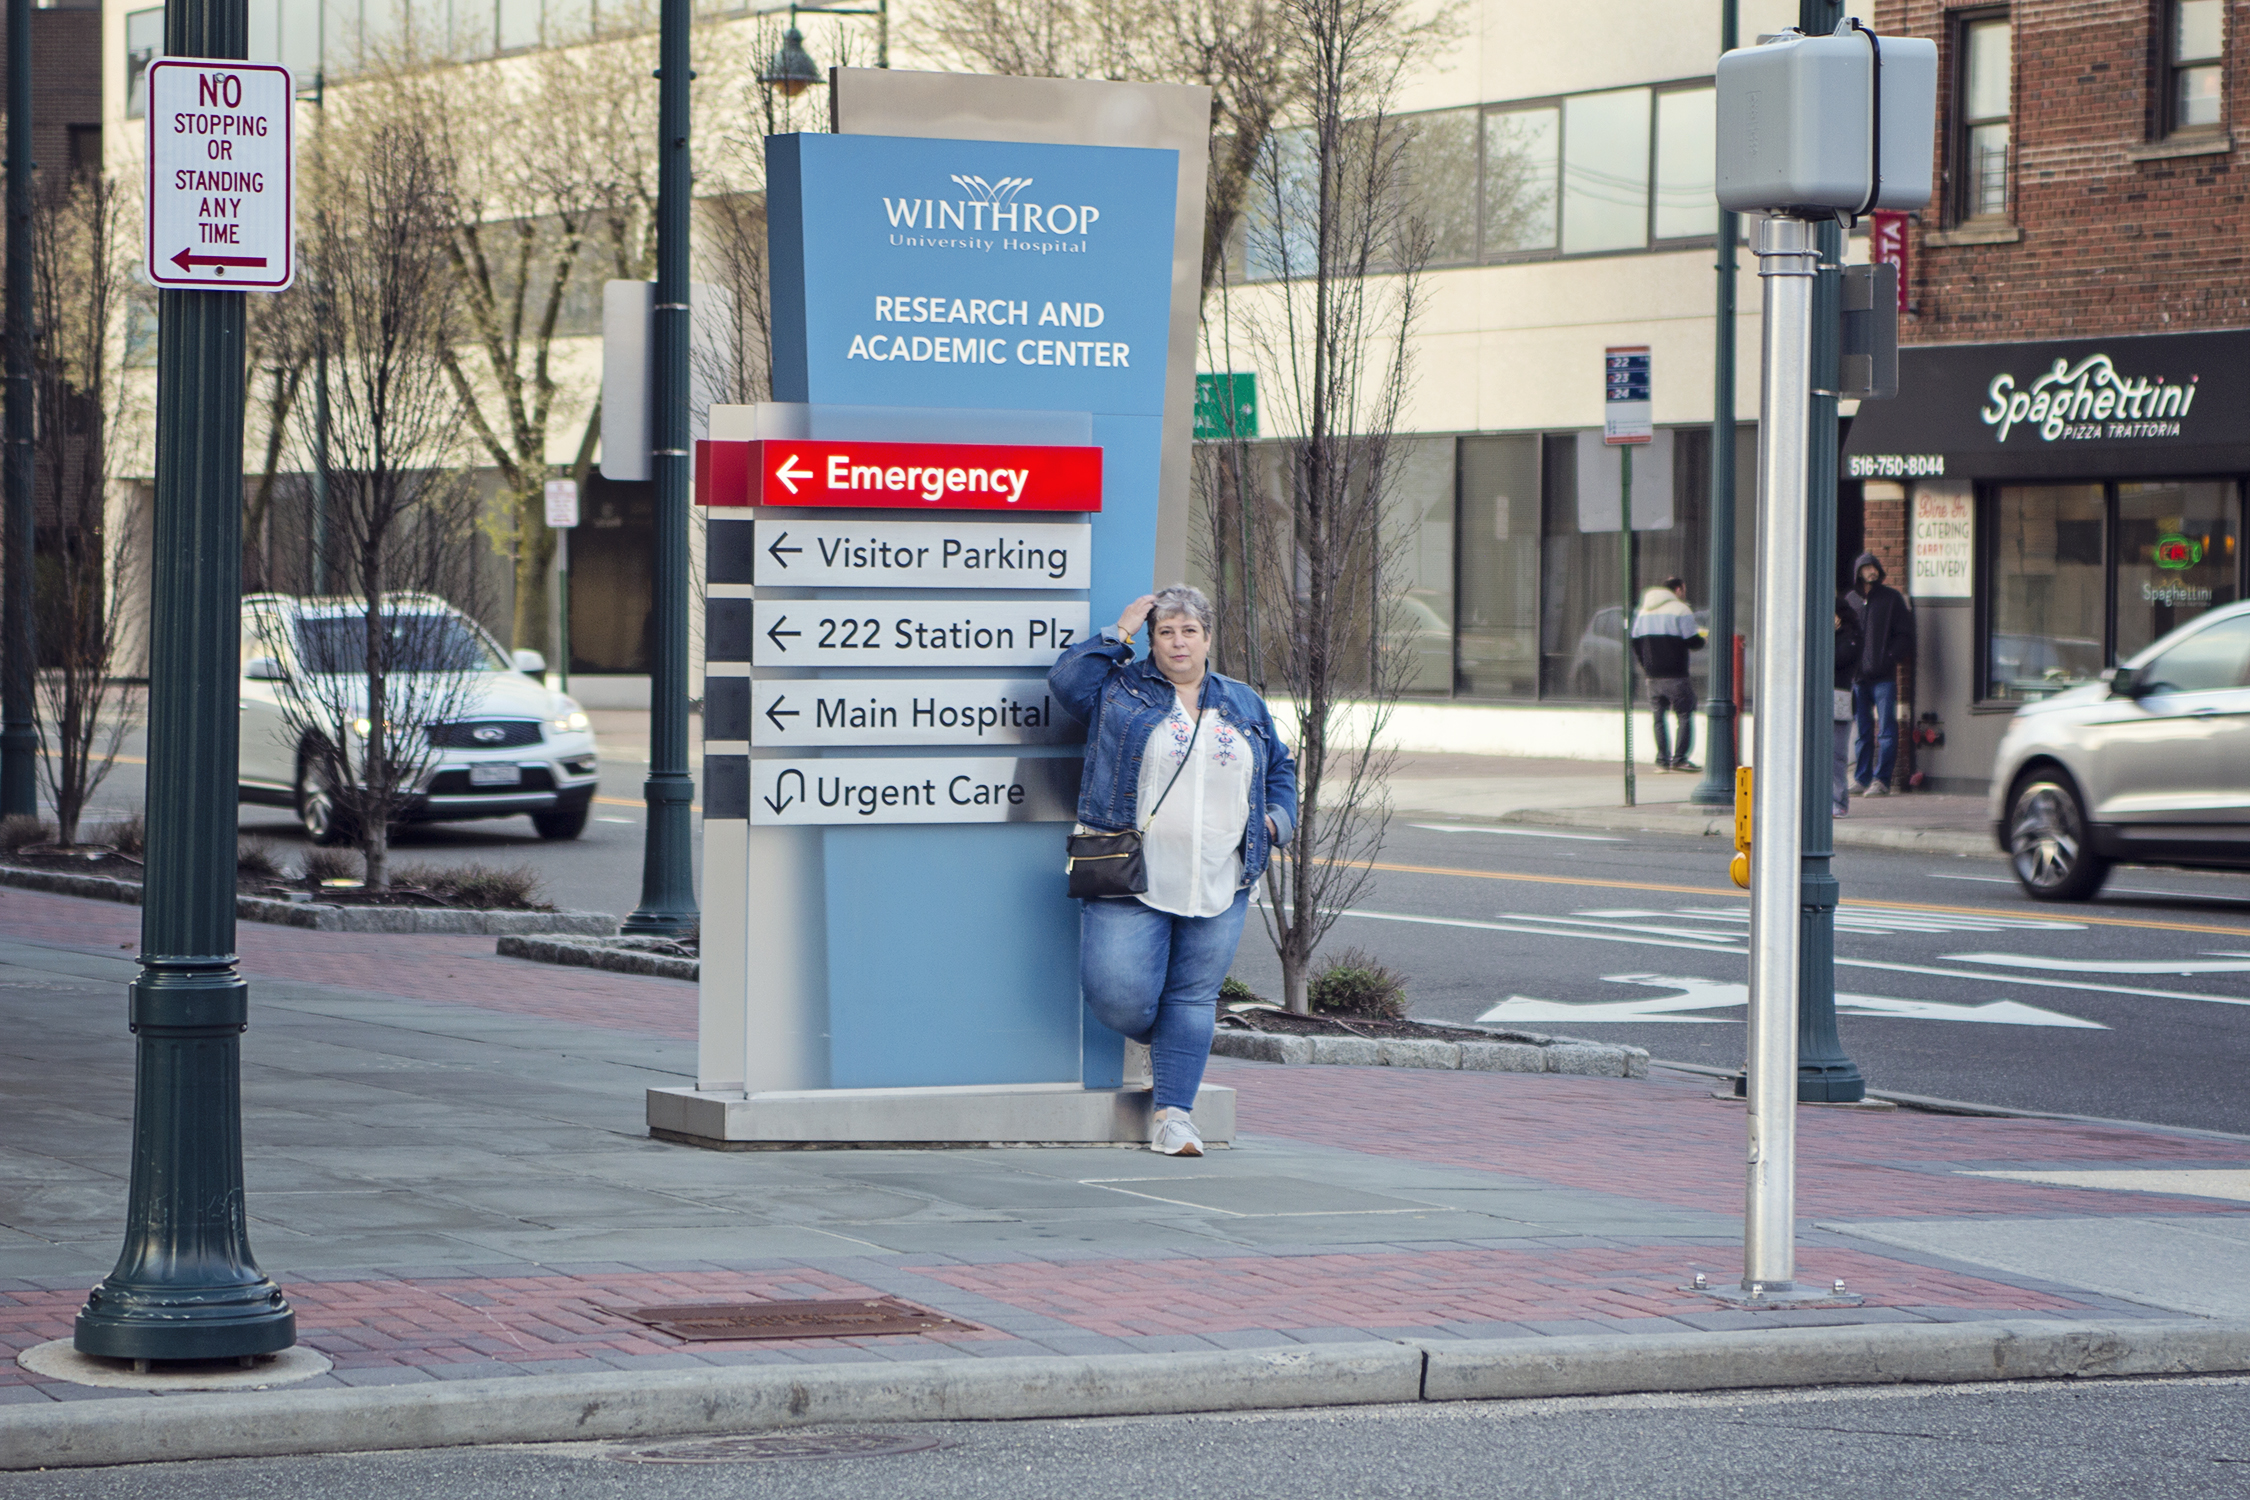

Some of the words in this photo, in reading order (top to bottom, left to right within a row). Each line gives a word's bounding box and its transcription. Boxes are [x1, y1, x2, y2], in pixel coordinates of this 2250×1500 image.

[199, 73, 242, 109] NO
[174, 112, 268, 137] STOPPING
[207, 139, 233, 161] OR
[175, 169, 264, 193] STANDING
[199, 197, 242, 219] ANY
[882, 196, 1100, 235] WINTHROP
[198, 222, 240, 244] TIME
[889, 233, 994, 253] University
[1003, 238, 1087, 255] Hospital
[875, 295, 1028, 326] RESEARCH
[1038, 301, 1105, 329] AND
[847, 334, 1007, 365] ACADEMIC
[1016, 339, 1130, 368] CENTER
[1981, 354, 2199, 442] Spaghettini
[2063, 423, 2102, 440] PIZZA
[2108, 421, 2181, 439] TRATTORIA
[1849, 454, 1944, 477] 516-750-8044
[827, 454, 1030, 503] Emergency
[1918, 495, 1948, 519] Dine
[1951, 494, 1968, 519] In
[1917, 522, 1969, 539] CATERING
[817, 537, 929, 569] Visitor
[943, 537, 1068, 579] Parking
[1916, 560, 1968, 578] DELIVERY
[2143, 583, 2213, 607] Spaghettini
[818, 618, 881, 649] 222
[894, 618, 1014, 649] Station
[1028, 617, 1075, 649] Plz
[816, 698, 897, 728] Main
[912, 696, 1050, 736] Hospital
[818, 777, 936, 816] Urgent
[949, 775, 1026, 805] Care
